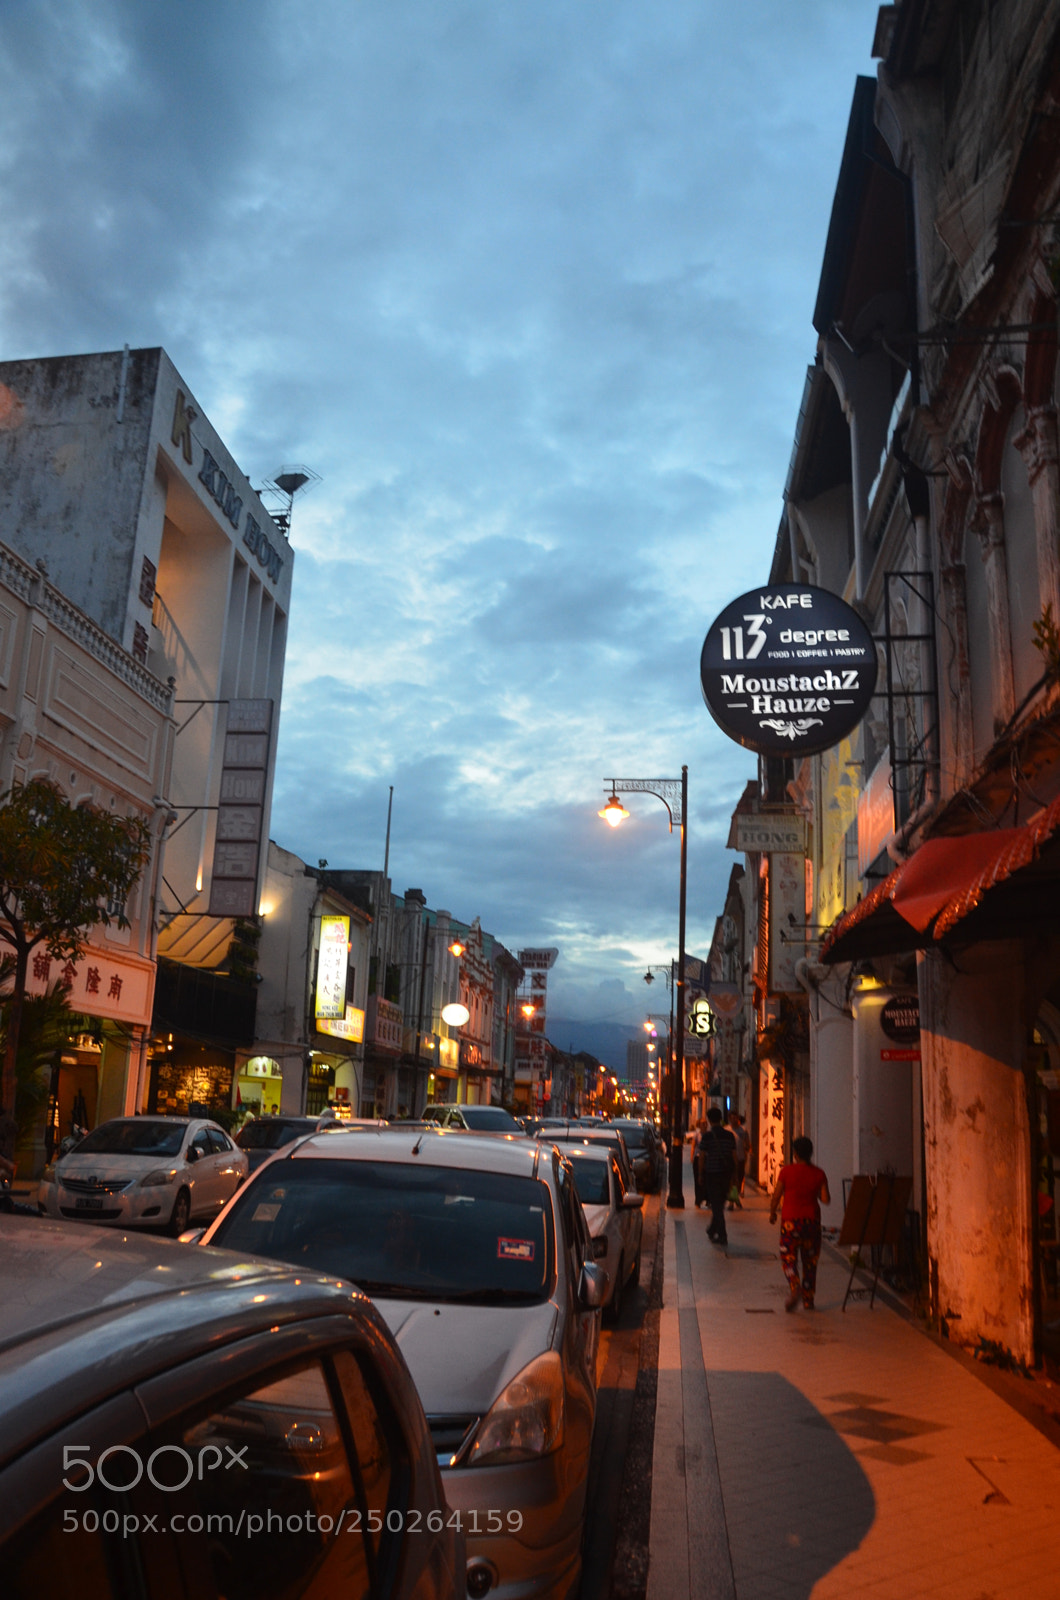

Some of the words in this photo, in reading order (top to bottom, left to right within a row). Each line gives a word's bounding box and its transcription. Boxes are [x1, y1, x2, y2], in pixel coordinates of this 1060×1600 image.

[760, 594, 812, 610] KAFE
[779, 628, 850, 646] degree
[767, 650, 790, 659] FOOD
[796, 649, 828, 658] COFFEE
[834, 647, 866, 656] PASTRY
[720, 670, 860, 694] MoustachZ
[751, 695, 831, 714] Hauze
[742, 832, 798, 843] HONG
